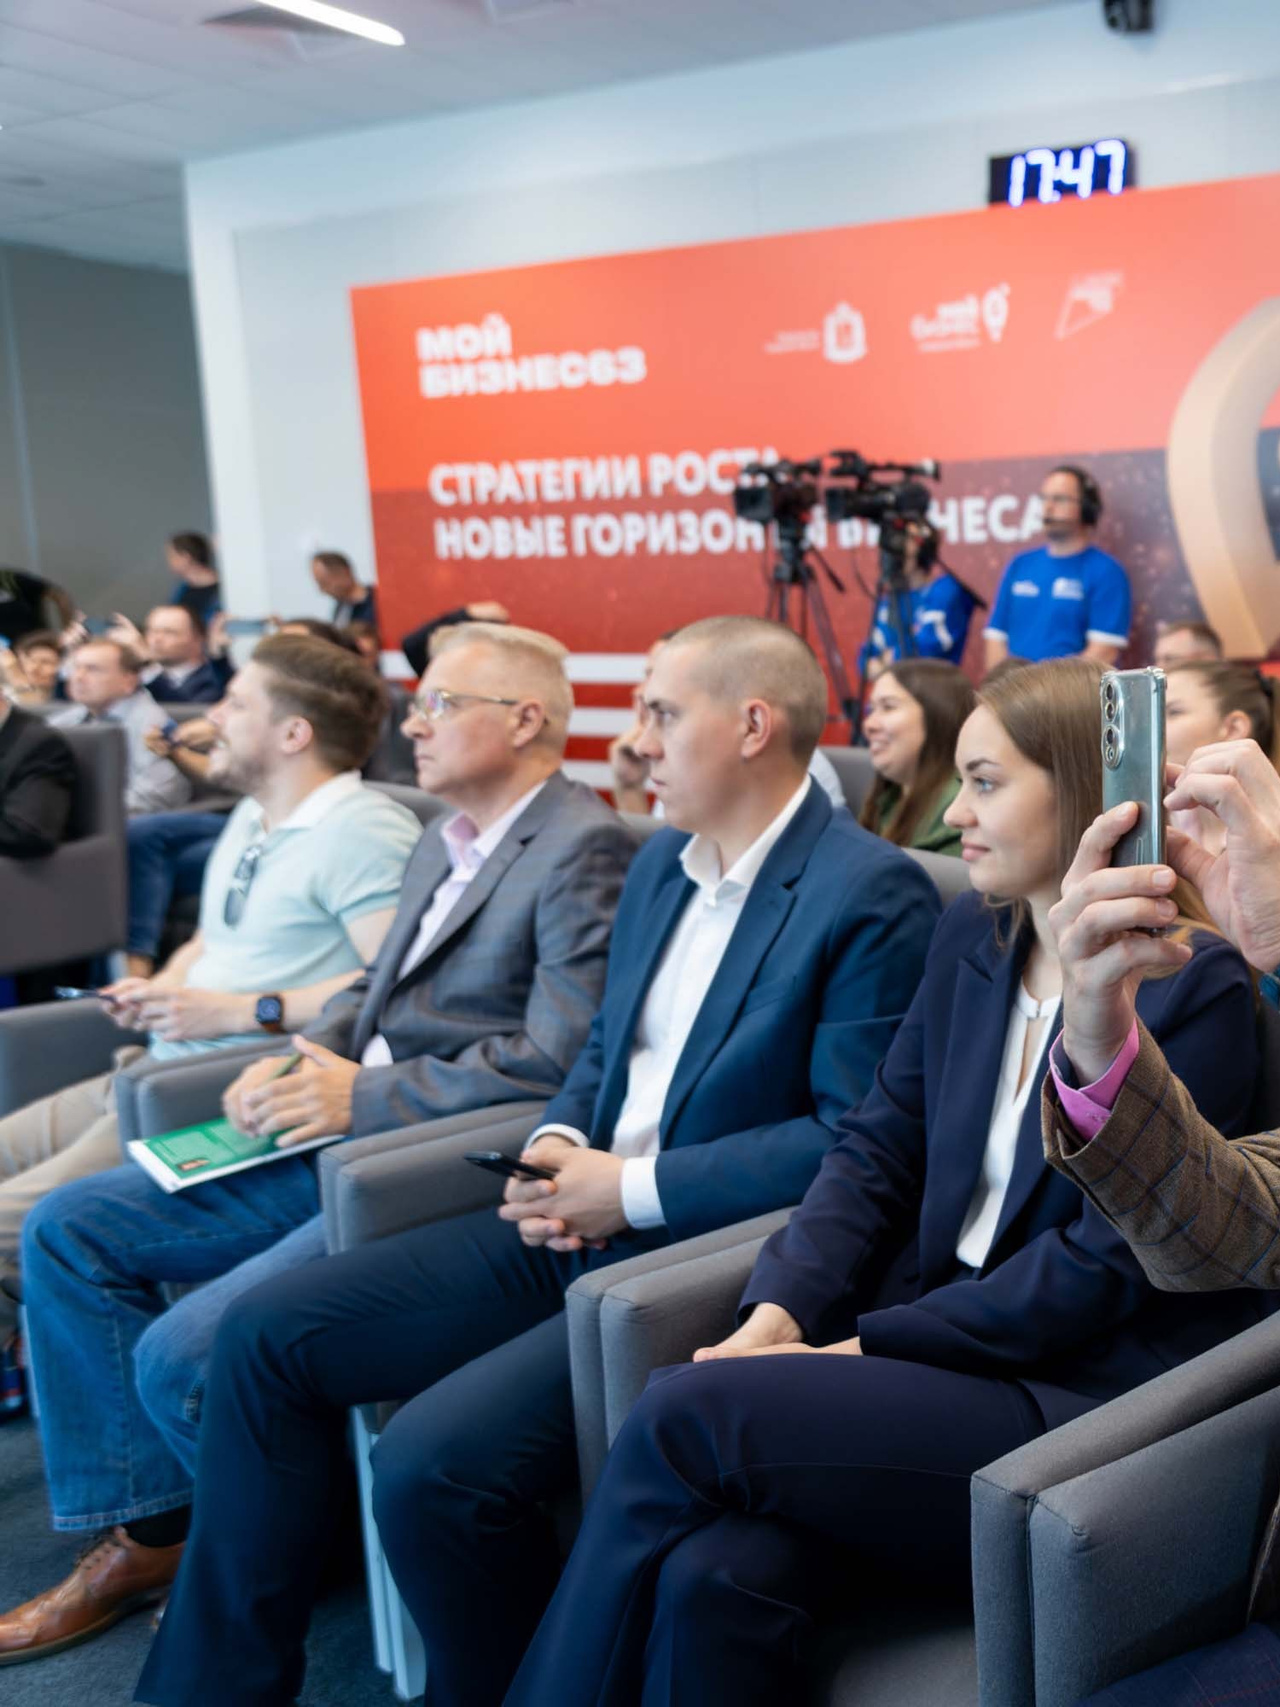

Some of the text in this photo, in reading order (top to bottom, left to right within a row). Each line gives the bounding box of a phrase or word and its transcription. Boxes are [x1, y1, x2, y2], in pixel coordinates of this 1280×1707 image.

[416, 311, 513, 363] МОЙ
[429, 454, 642, 506] СТРАТЕГИИ
[434, 514, 568, 560] НОВЫЕ
[571, 505, 828, 558] ГОРИЗОНЫ
